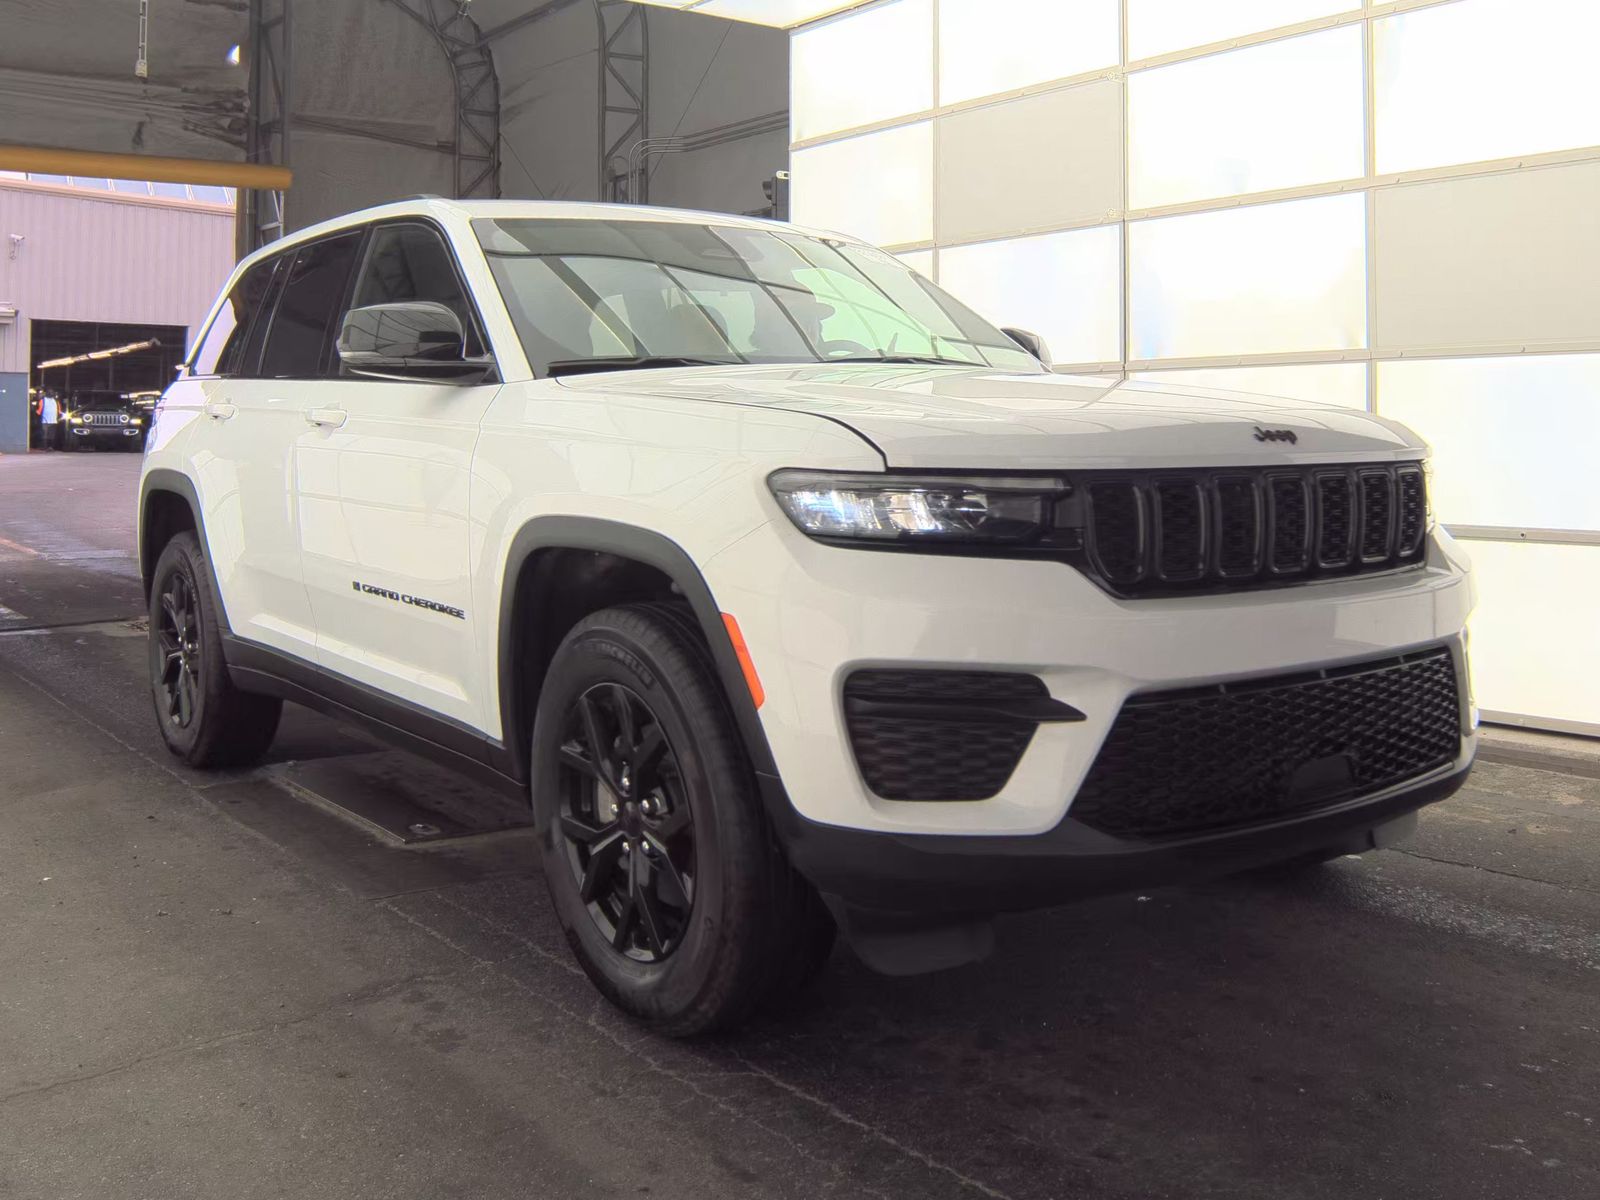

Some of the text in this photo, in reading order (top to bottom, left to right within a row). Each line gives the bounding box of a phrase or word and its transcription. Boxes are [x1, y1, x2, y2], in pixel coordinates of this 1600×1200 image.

[1253, 426, 1297, 445] Jeep
[362, 584, 465, 620] GRAND CHEROKEE
